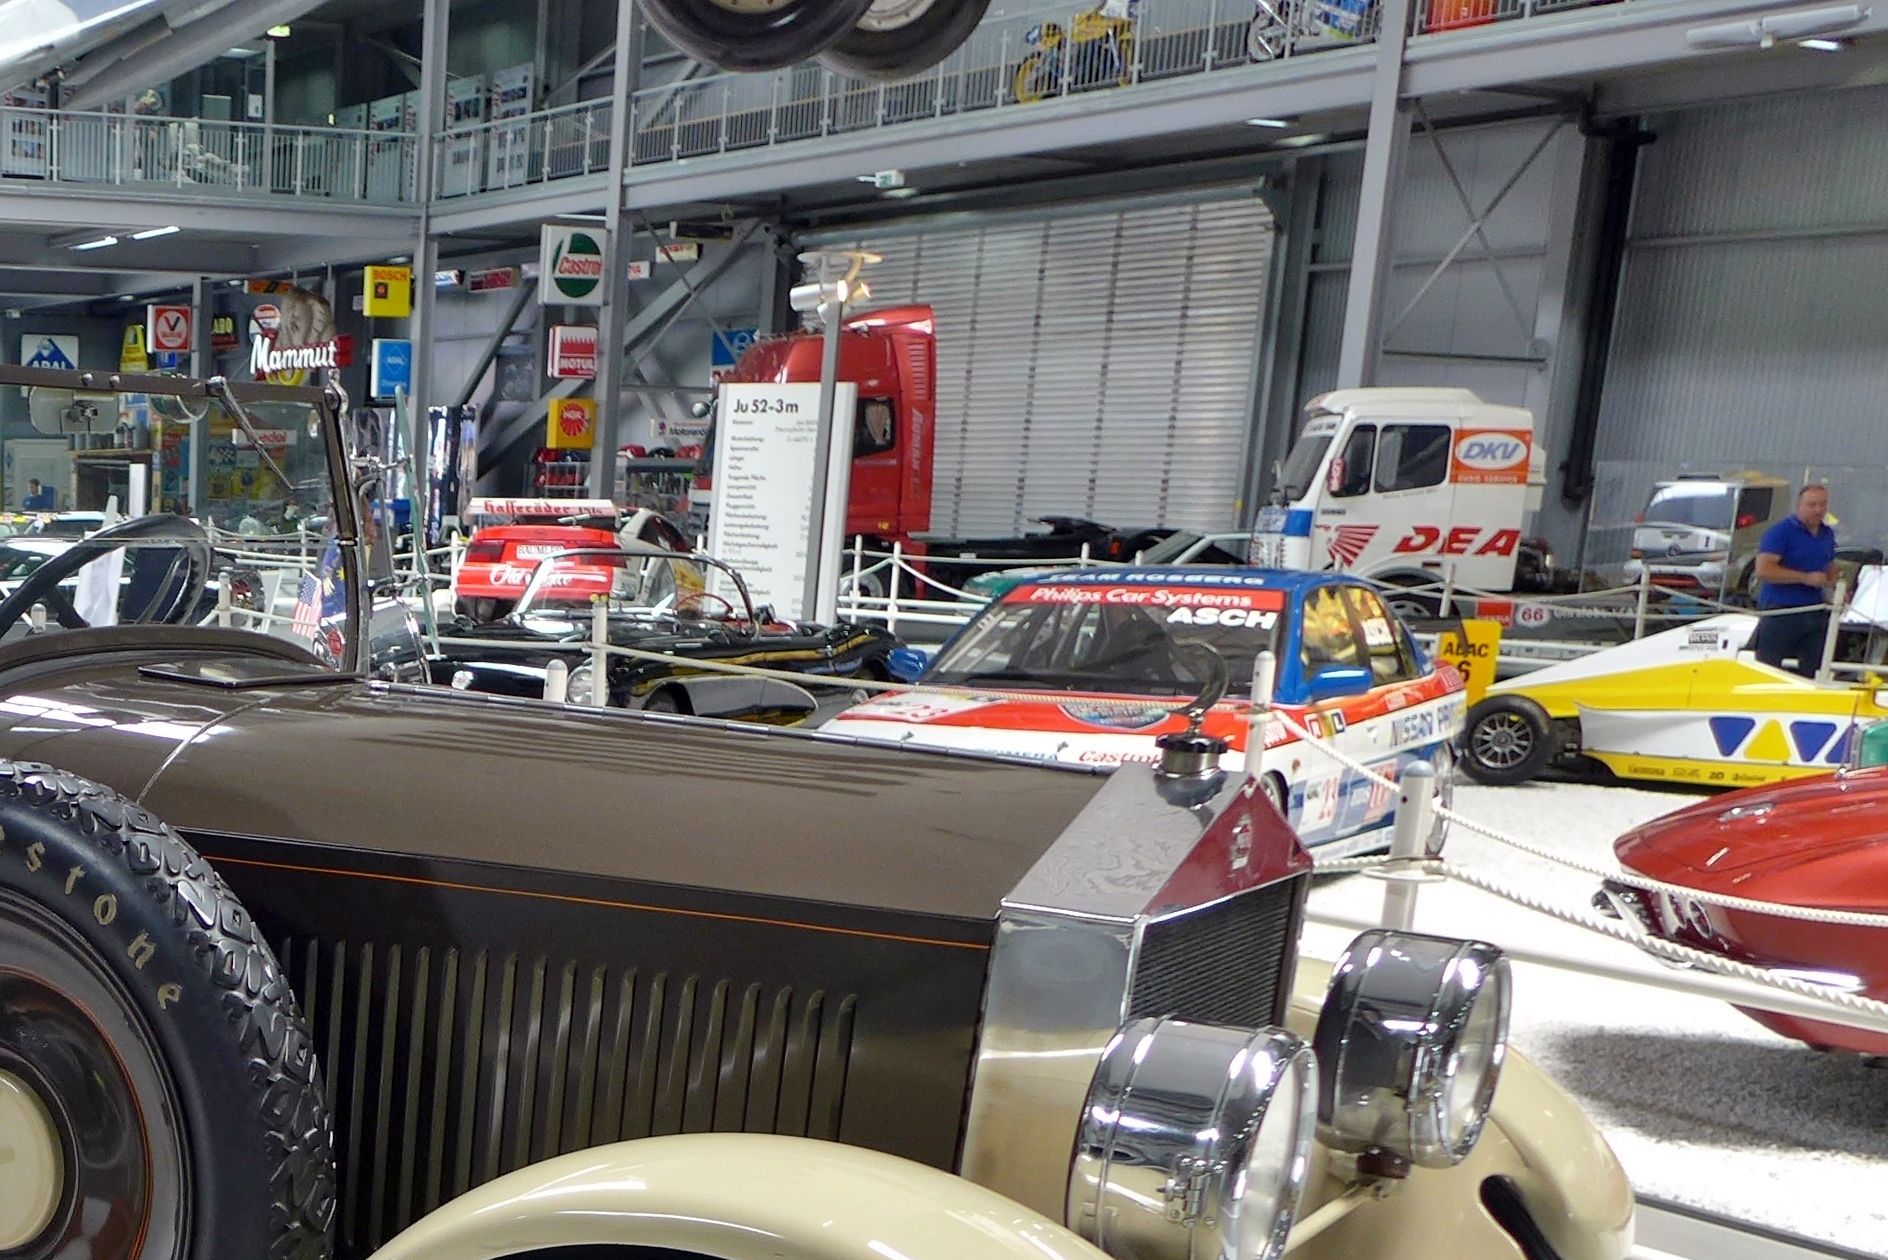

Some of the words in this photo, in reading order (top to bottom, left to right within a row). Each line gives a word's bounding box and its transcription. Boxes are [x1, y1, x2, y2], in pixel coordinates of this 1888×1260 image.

[372, 269, 408, 282] BOSCH
[250, 334, 338, 375] Mammut
[561, 357, 595, 371] MOTUL
[733, 399, 749, 413] Ju
[1463, 442, 1520, 460] DKV
[1392, 525, 1521, 557] DEA
[1029, 587, 1102, 605] Philips
[1105, 588, 1149, 603] Car
[1150, 589, 1253, 608] Systems
[1166, 607, 1280, 631] ASCH
[1521, 607, 1544, 622] 66
